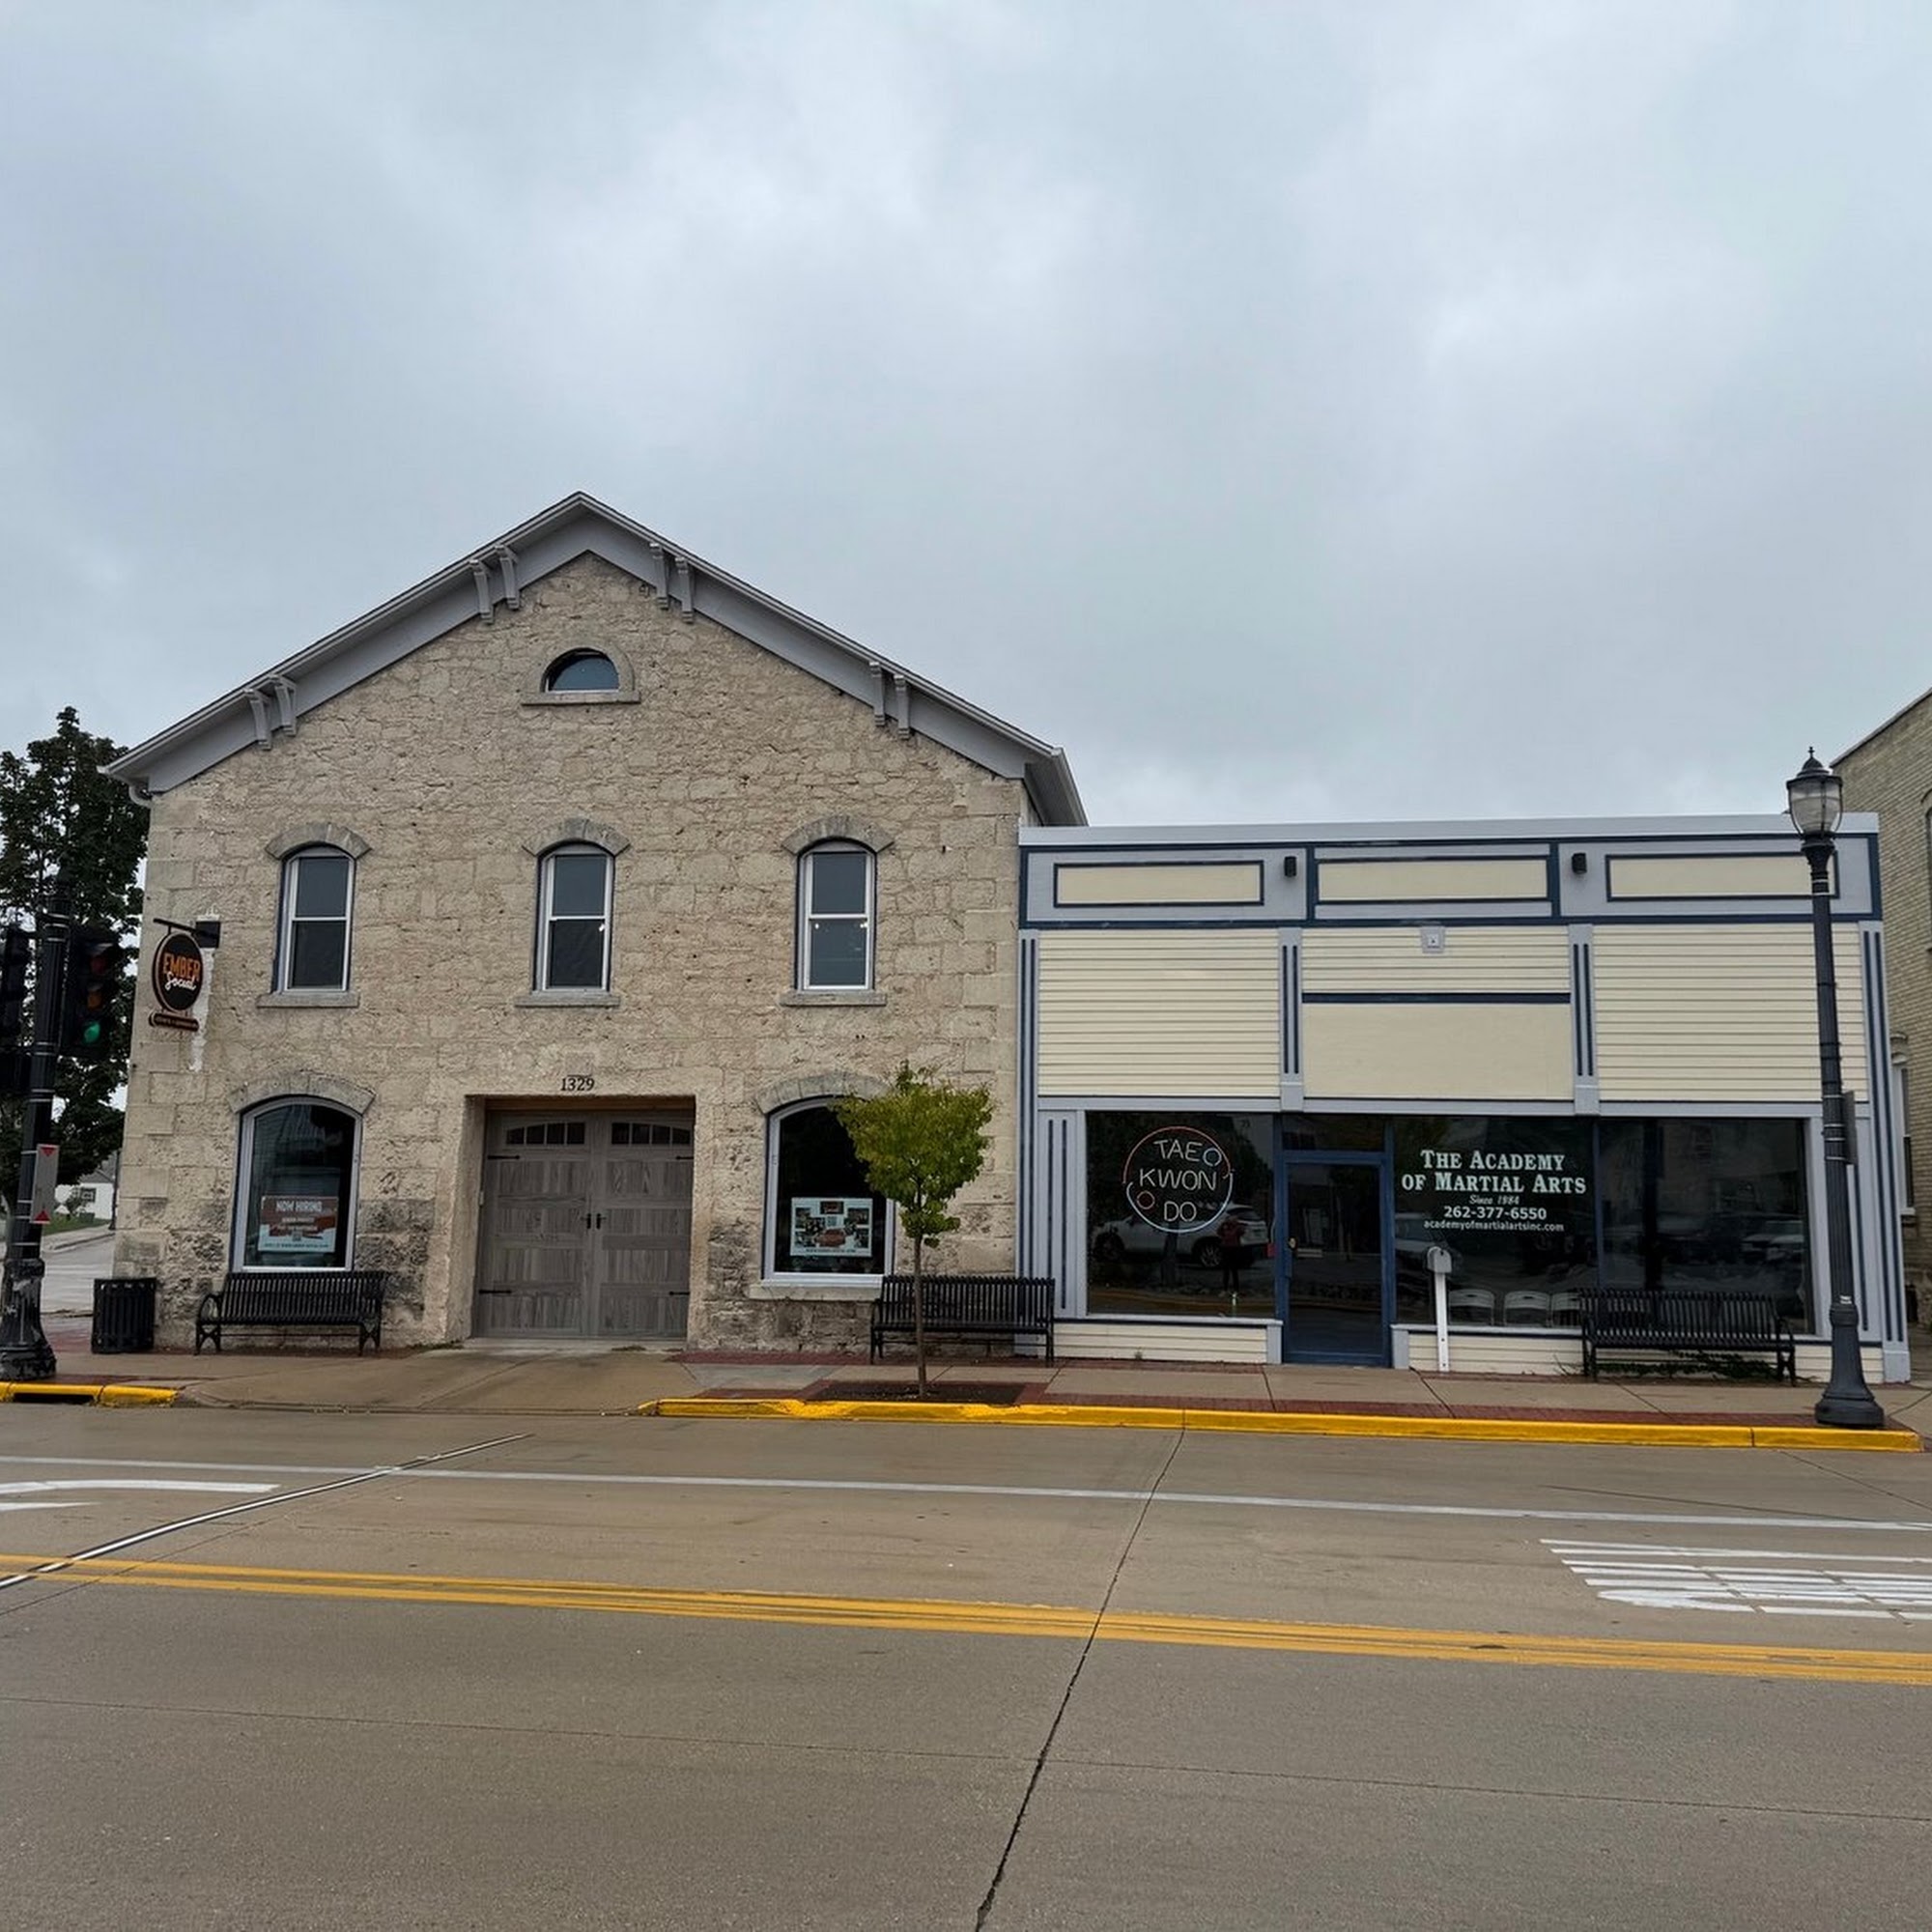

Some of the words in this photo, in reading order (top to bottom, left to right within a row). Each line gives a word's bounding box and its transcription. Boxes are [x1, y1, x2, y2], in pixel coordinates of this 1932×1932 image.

[163, 952, 201, 981] EMBER
[164, 971, 197, 991] Social
[561, 1077, 595, 1092] 1329
[1420, 1150, 1463, 1169] THE
[1469, 1150, 1566, 1171] ACADEMY
[1139, 1168, 1217, 1191] KWON
[1402, 1174, 1427, 1191] OF
[1435, 1172, 1525, 1193] MARTIAL
[1532, 1174, 1587, 1194] ARTS
[275, 1200, 295, 1212] NOW
[296, 1201, 323, 1212] HIRING
[1468, 1195, 1493, 1205] Since
[1163, 1200, 1197, 1222] DO
[1443, 1206, 1548, 1220] 262-377-6550
[1423, 1220, 1565, 1232] academyofmartialartsinc.com
